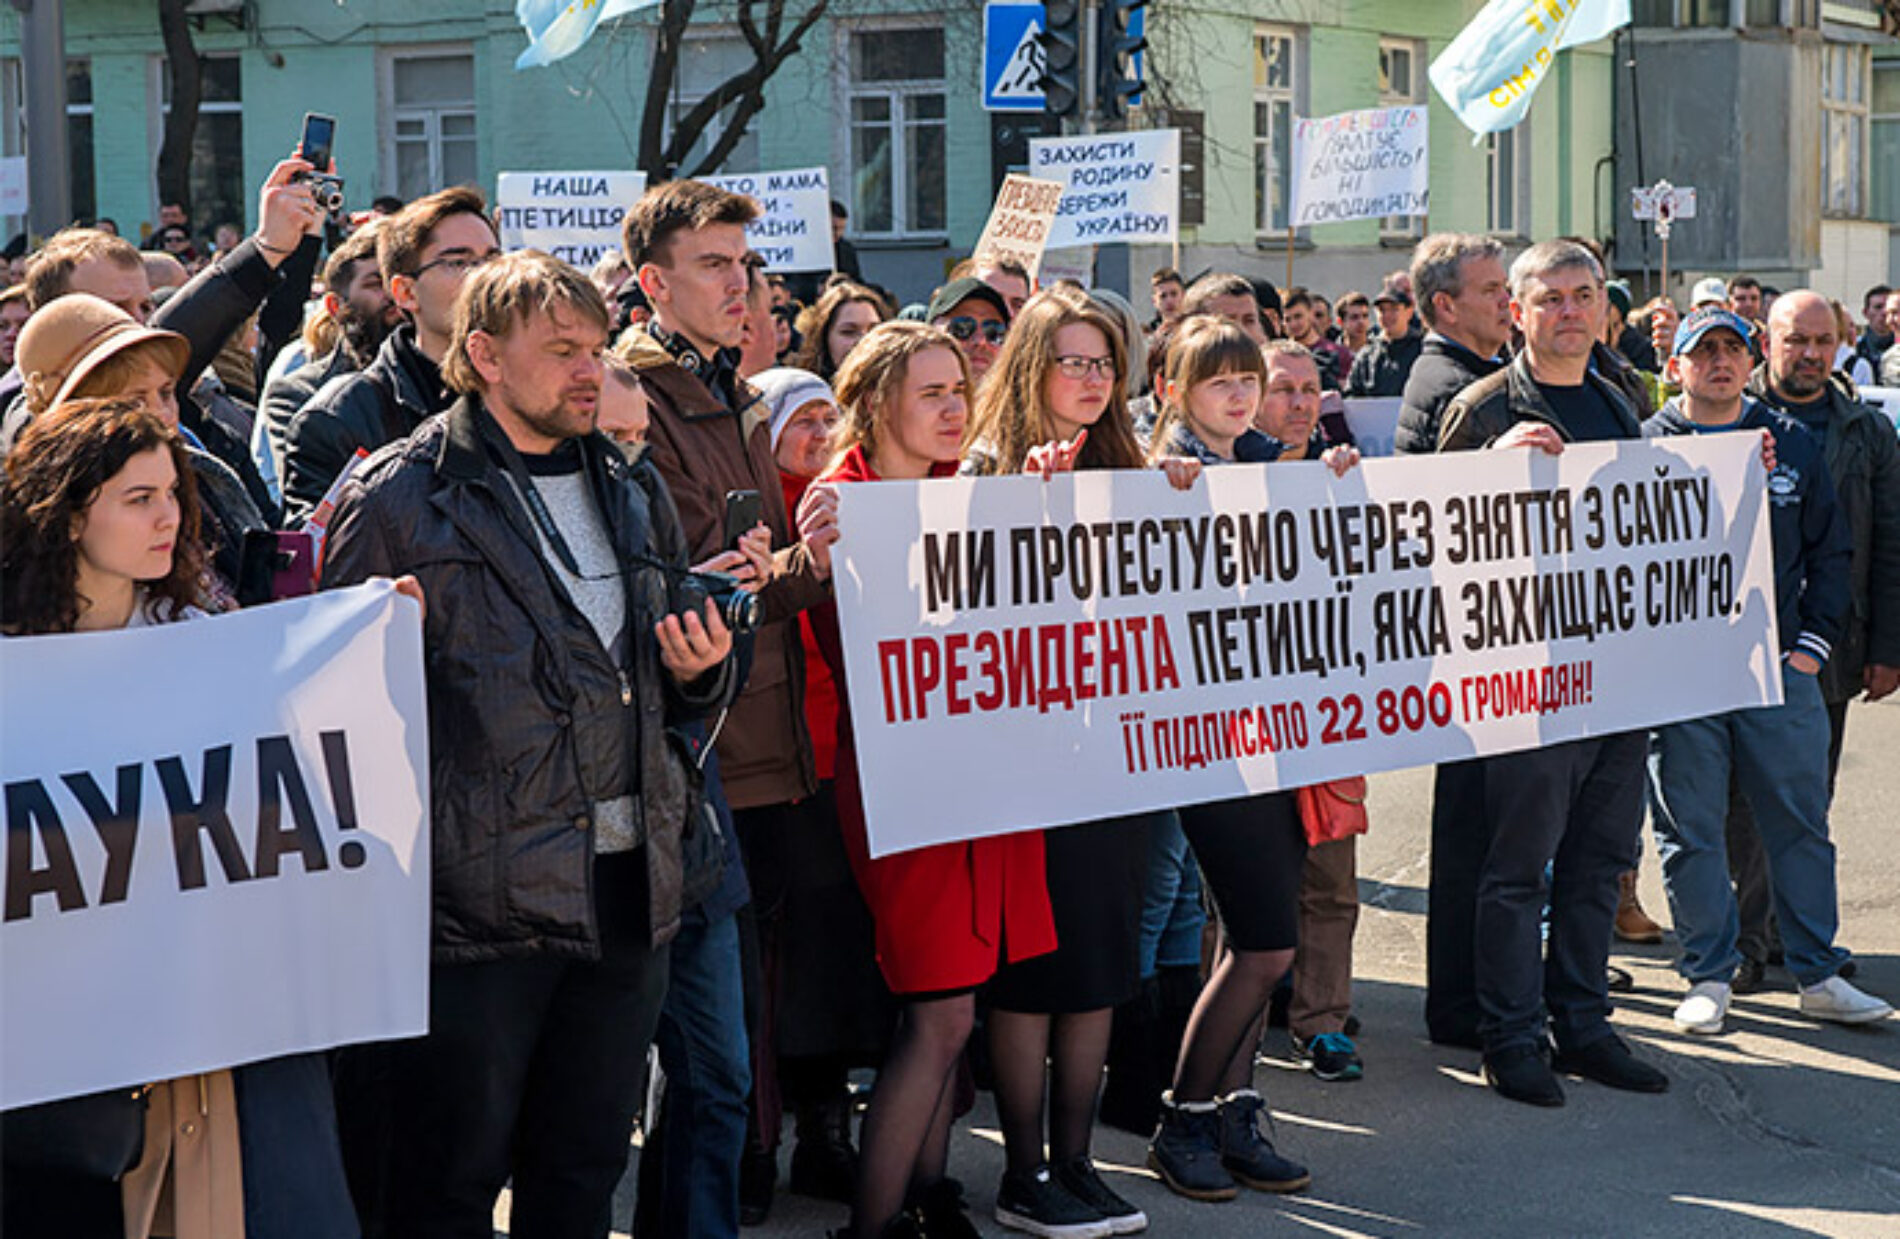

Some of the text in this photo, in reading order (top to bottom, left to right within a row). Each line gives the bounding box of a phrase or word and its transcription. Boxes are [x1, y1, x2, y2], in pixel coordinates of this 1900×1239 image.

[1039, 141, 1135, 166] ЗАХИСТИ
[532, 177, 609, 196] НАША
[1071, 162, 1155, 187] РОДИНУ
[503, 207, 625, 230] ПЕТИЦІЯ
[1076, 212, 1168, 238] УКРАЇНУ!
[925, 530, 995, 612] МИ
[1011, 509, 1299, 606] ПРОТЕСТУЄМО
[1310, 500, 1435, 577] ЧЕРЕЗ
[1445, 489, 1573, 564] ЗНЯТТЯ
[1583, 486, 1605, 550] З
[1612, 466, 1710, 548] САЙТУ
[878, 552, 1742, 723] ПРЕЗИДЕНТА ПЕТИЦІЇ, ЯКА ЗАХИЩАЄ СІМ'Ю.
[1120, 660, 1593, 774] ЇЇ ПІДПИСАЛО 22 800 ГРОМАДЯН!
